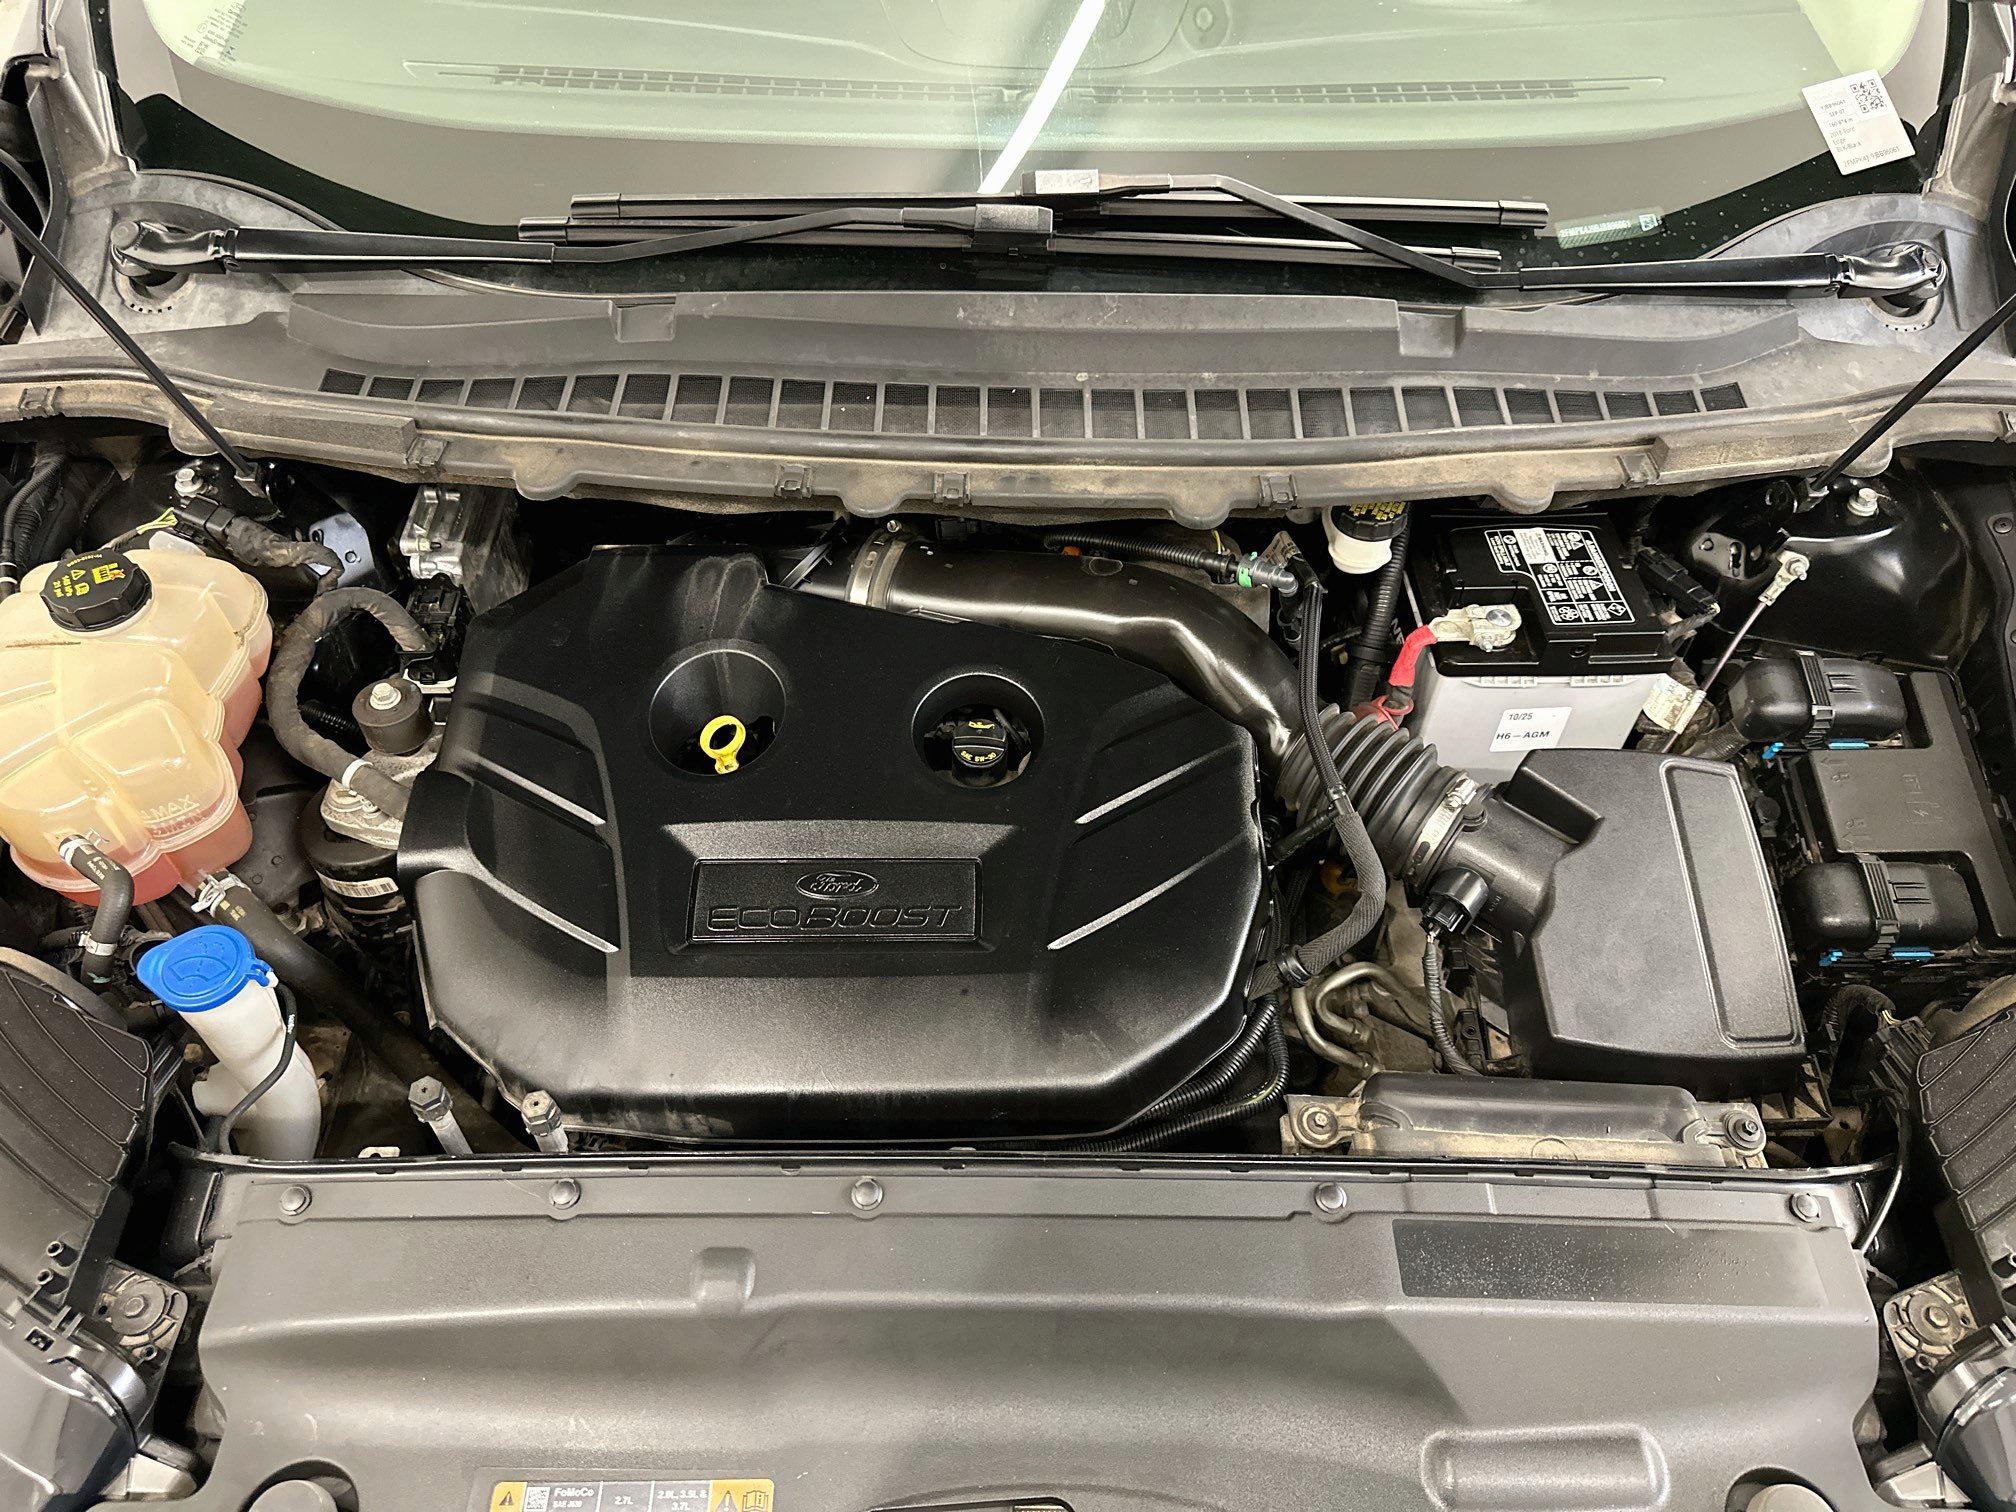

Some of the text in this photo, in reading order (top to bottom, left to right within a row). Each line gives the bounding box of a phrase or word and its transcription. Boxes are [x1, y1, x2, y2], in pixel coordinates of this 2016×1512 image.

[1833, 137, 1846, 146] Edge
[1523, 731, 1550, 739] AGM
[961, 750, 973, 761] SAE
[150, 794, 197, 820] MAX
[809, 873, 863, 894] Ford
[706, 905, 963, 932] ECOBOOST
[554, 1487, 595, 1498] FoMoCo
[614, 1495, 634, 1505] 2.7L
[671, 1501, 690, 1511] 3.7L
